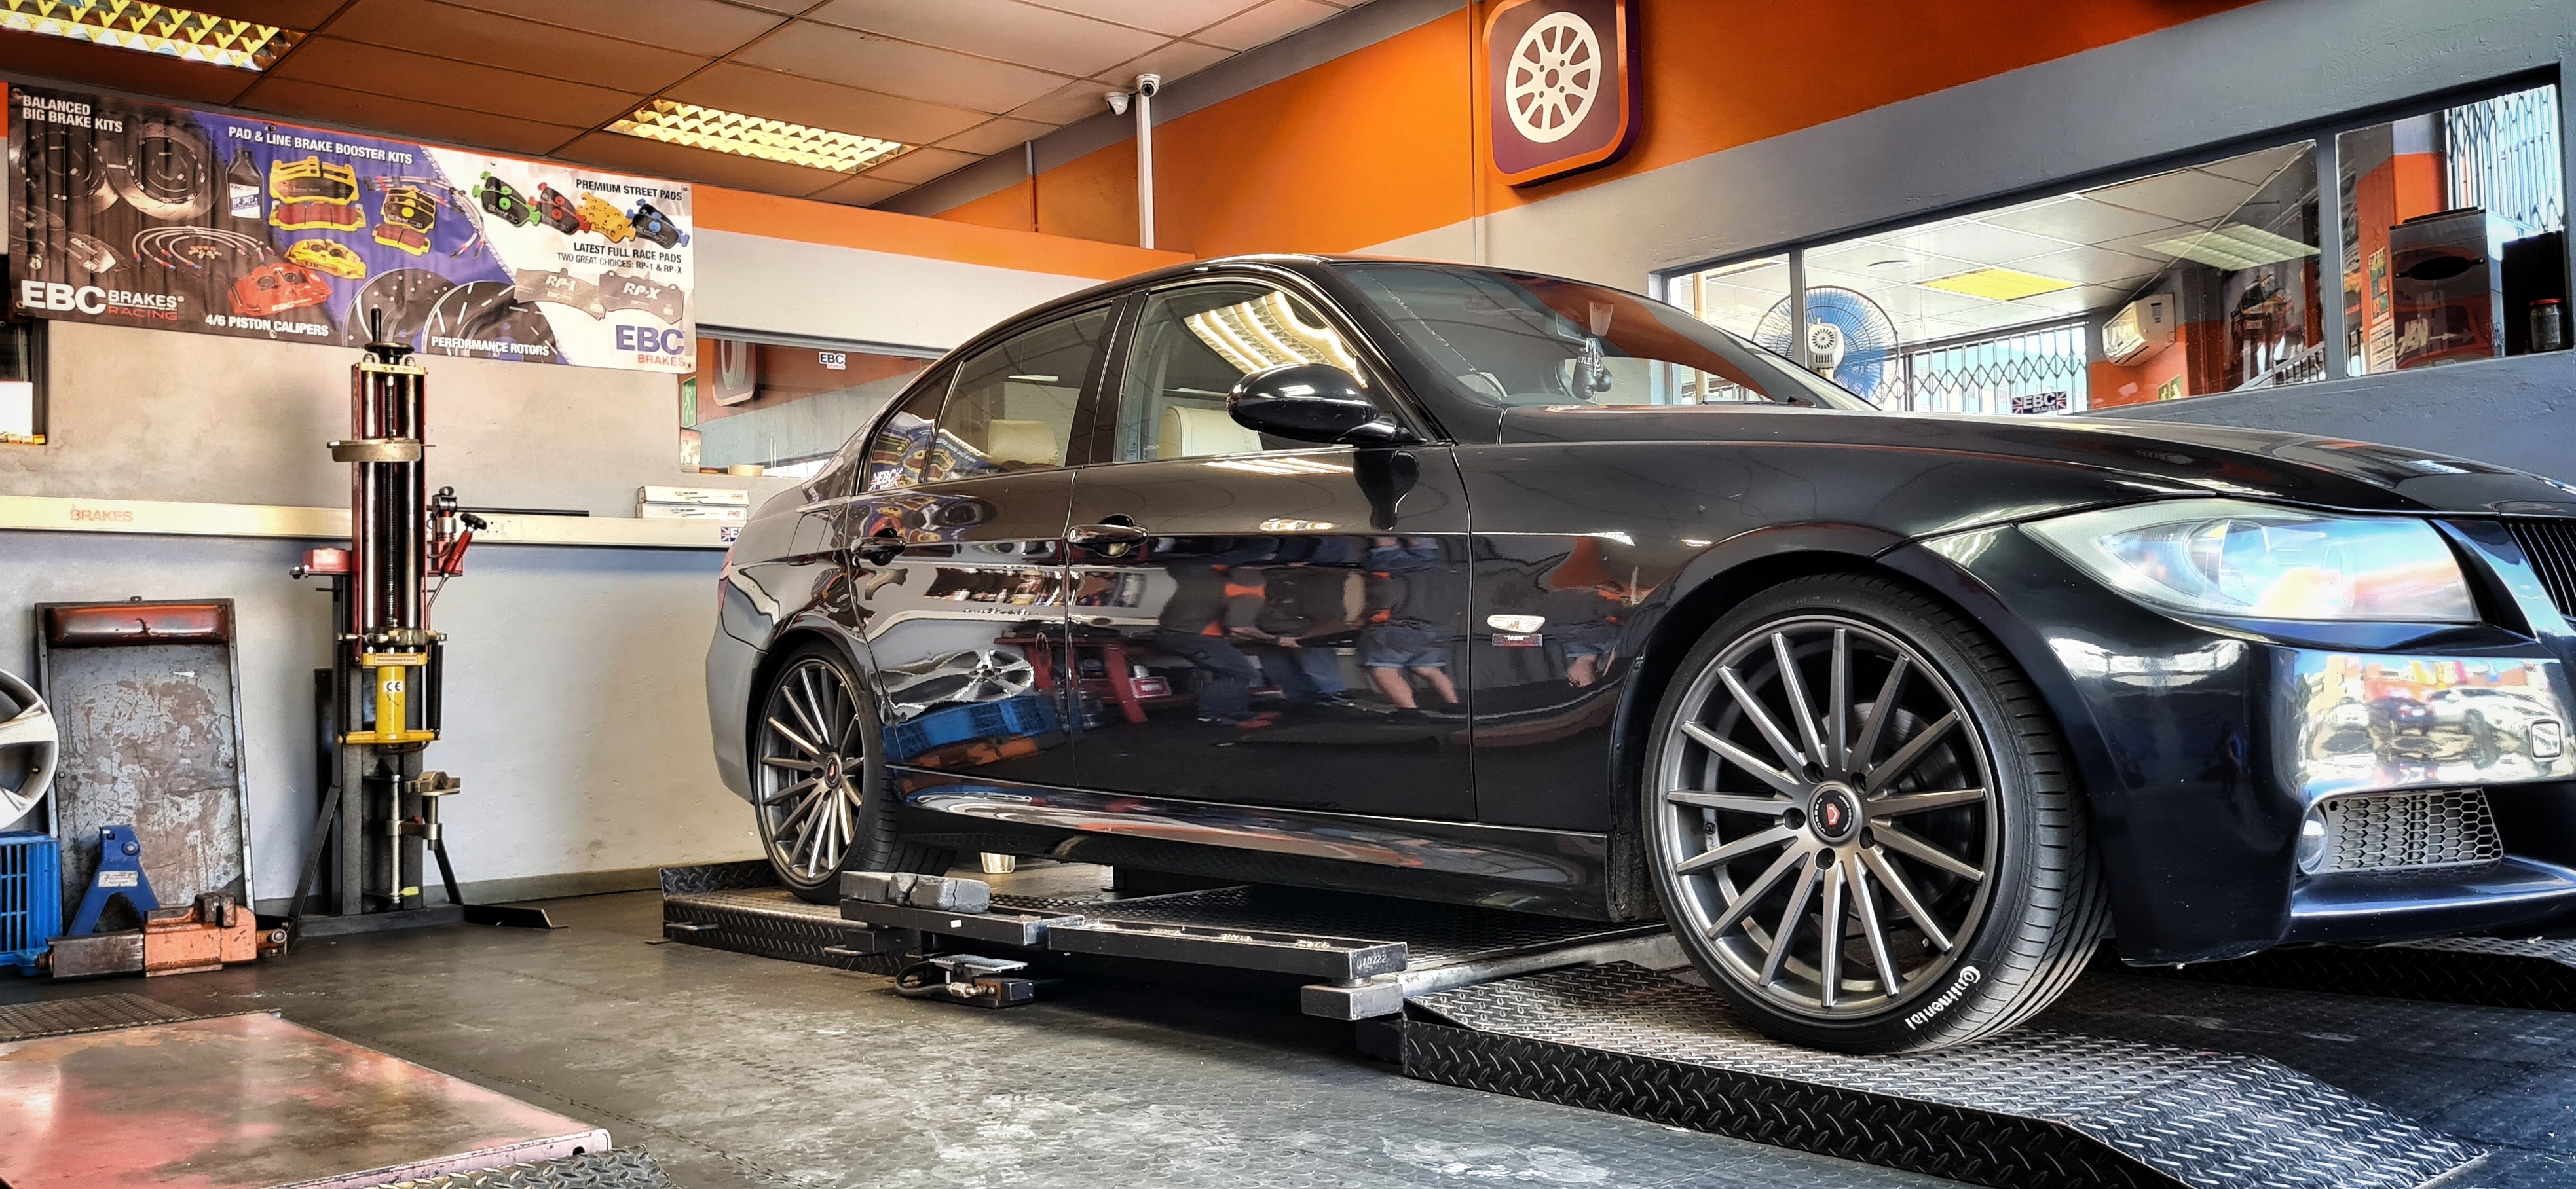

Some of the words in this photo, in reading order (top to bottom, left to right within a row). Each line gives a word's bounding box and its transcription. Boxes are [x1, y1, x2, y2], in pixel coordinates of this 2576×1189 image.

[23, 95, 90, 115] BALANCED
[23, 107, 45, 121] BIG
[48, 111, 92, 128] BRAKE
[94, 117, 123, 133] KITS
[229, 126, 252, 141] PAD
[255, 131, 263, 143] &
[267, 133, 291, 147] LINE
[295, 137, 333, 153] BRAKE
[336, 143, 385, 161] BOOSTER
[388, 151, 413, 164] KITS
[576, 179, 621, 193] PREMIUM
[624, 185, 658, 198] STREET
[660, 190, 682, 201] PADS
[574, 242, 605, 255] LATEST
[608, 247, 630, 257] FULL
[633, 249, 656, 260] RACE
[659, 252, 682, 263] PADS
[557, 252, 574, 262] TWO
[576, 255, 597, 265] GREAT
[599, 258, 634, 268] CHOICES:
[636, 261, 653, 270] RP-1
[656, 263, 662, 272] &
[663, 265, 682, 274] RP-X
[545, 274, 576, 291] RP-1
[622, 282, 662, 300] RP-X
[21, 280, 107, 315] EBC
[108, 306, 177, 320] RACING
[205, 314, 226, 327] 4/6
[229, 316, 271, 331] PISTON
[274, 321, 329, 337] CALIPERS
[431, 336, 508, 353] PERFORMANCE
[510, 343, 550, 356] ROTORS
[616, 325, 684, 355] EBC
[638, 354, 686, 367] BRAKES
[820, 354, 844, 364] EBC
[2023, 393, 2056, 409] EBC
[876, 469, 896, 485] EBC
[70, 509, 133, 522] BRAKES
[1905, 966, 1981, 1031] Continental
